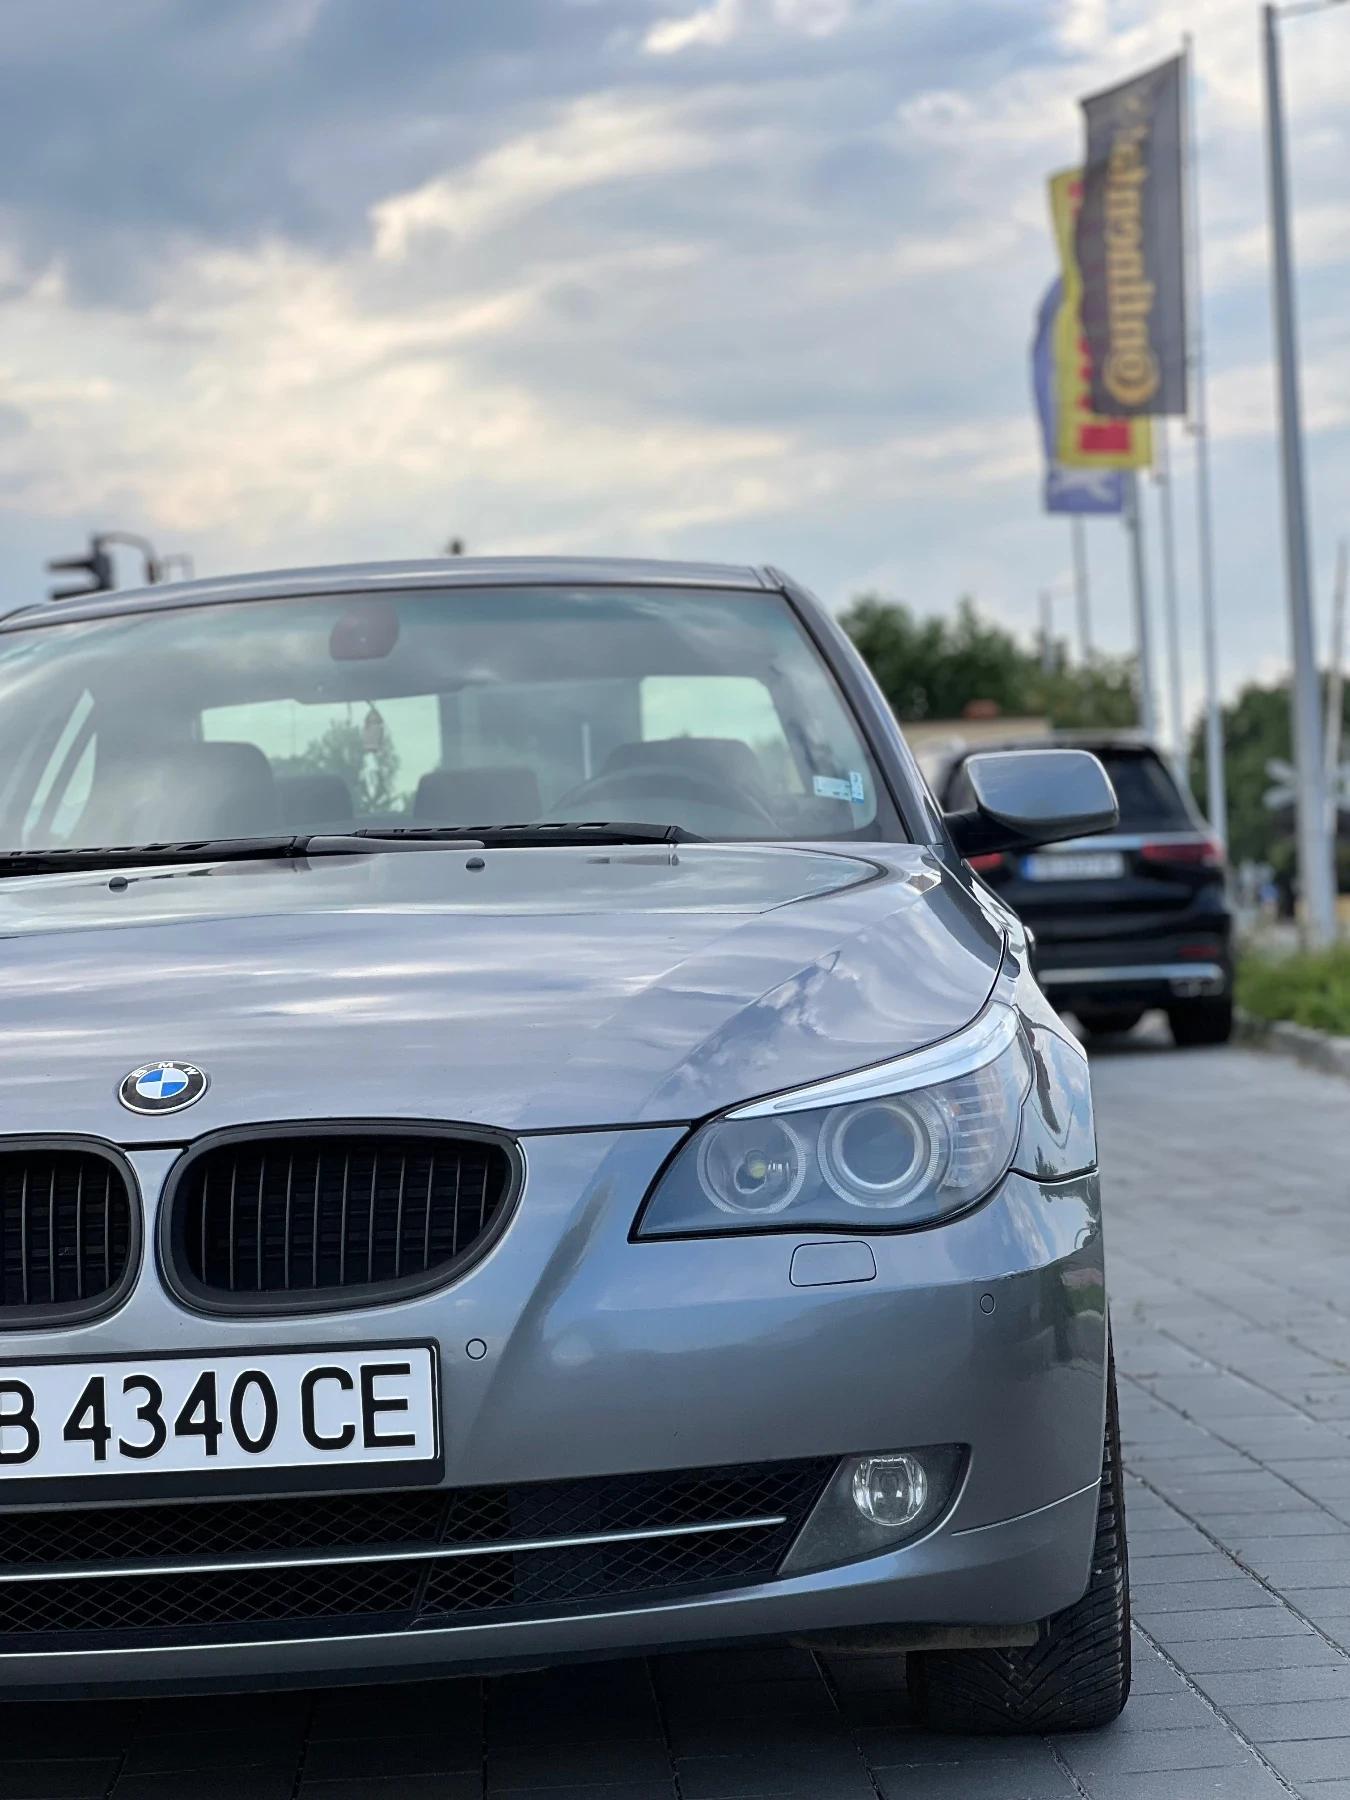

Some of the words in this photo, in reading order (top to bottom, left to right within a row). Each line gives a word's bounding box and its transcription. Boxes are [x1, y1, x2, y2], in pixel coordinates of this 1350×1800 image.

[132, 1062, 199, 1077] BMW
[0, 1379, 40, 1465] B
[63, 1370, 279, 1462] 4340
[301, 1362, 416, 1451] CE
